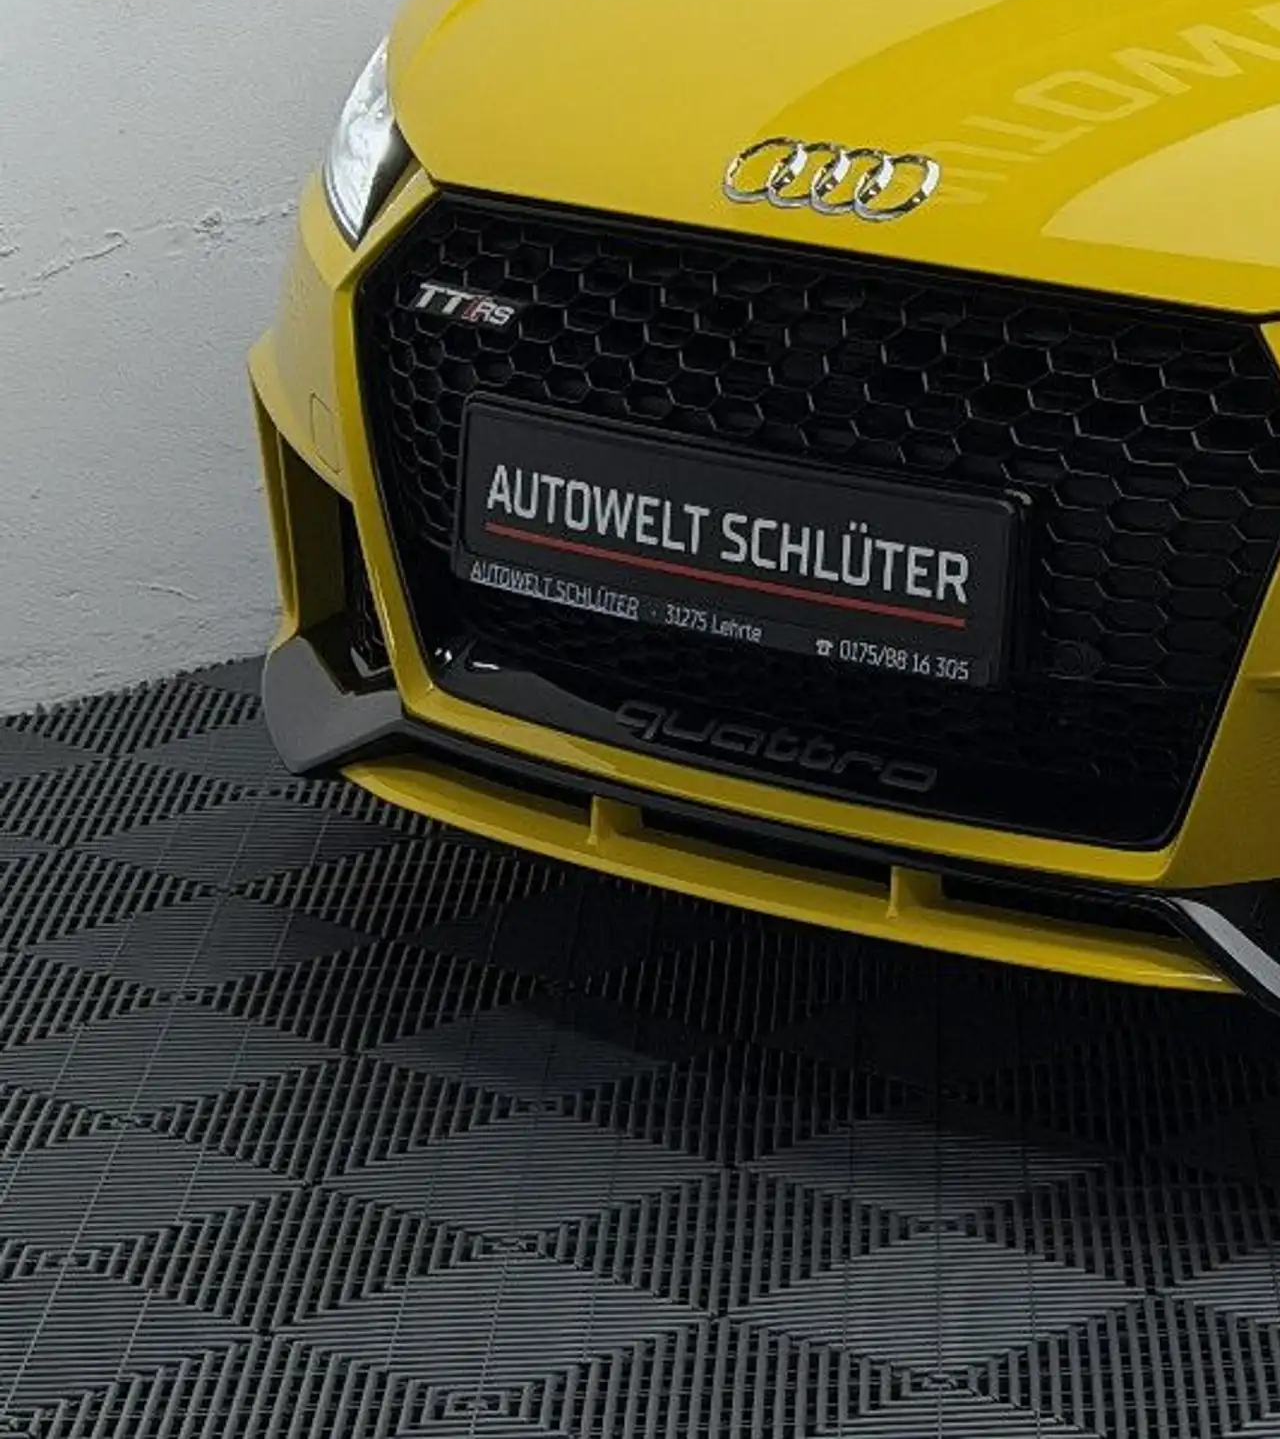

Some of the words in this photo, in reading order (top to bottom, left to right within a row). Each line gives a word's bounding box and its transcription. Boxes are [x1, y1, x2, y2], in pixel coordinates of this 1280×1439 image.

[486, 464, 710, 555] AUTOWELT
[720, 513, 970, 604] SCHLÜTER
[470, 561, 553, 599] AUTOWELT
[555, 580, 640, 619] SCHLÜTER
[665, 603, 708, 632] 31275
[710, 613, 763, 644] Lehrte
[839, 640, 908, 671] 0175/88
[911, 652, 931, 675] 16
[935, 656, 969, 680] 305
[614, 698, 938, 793] quattro
